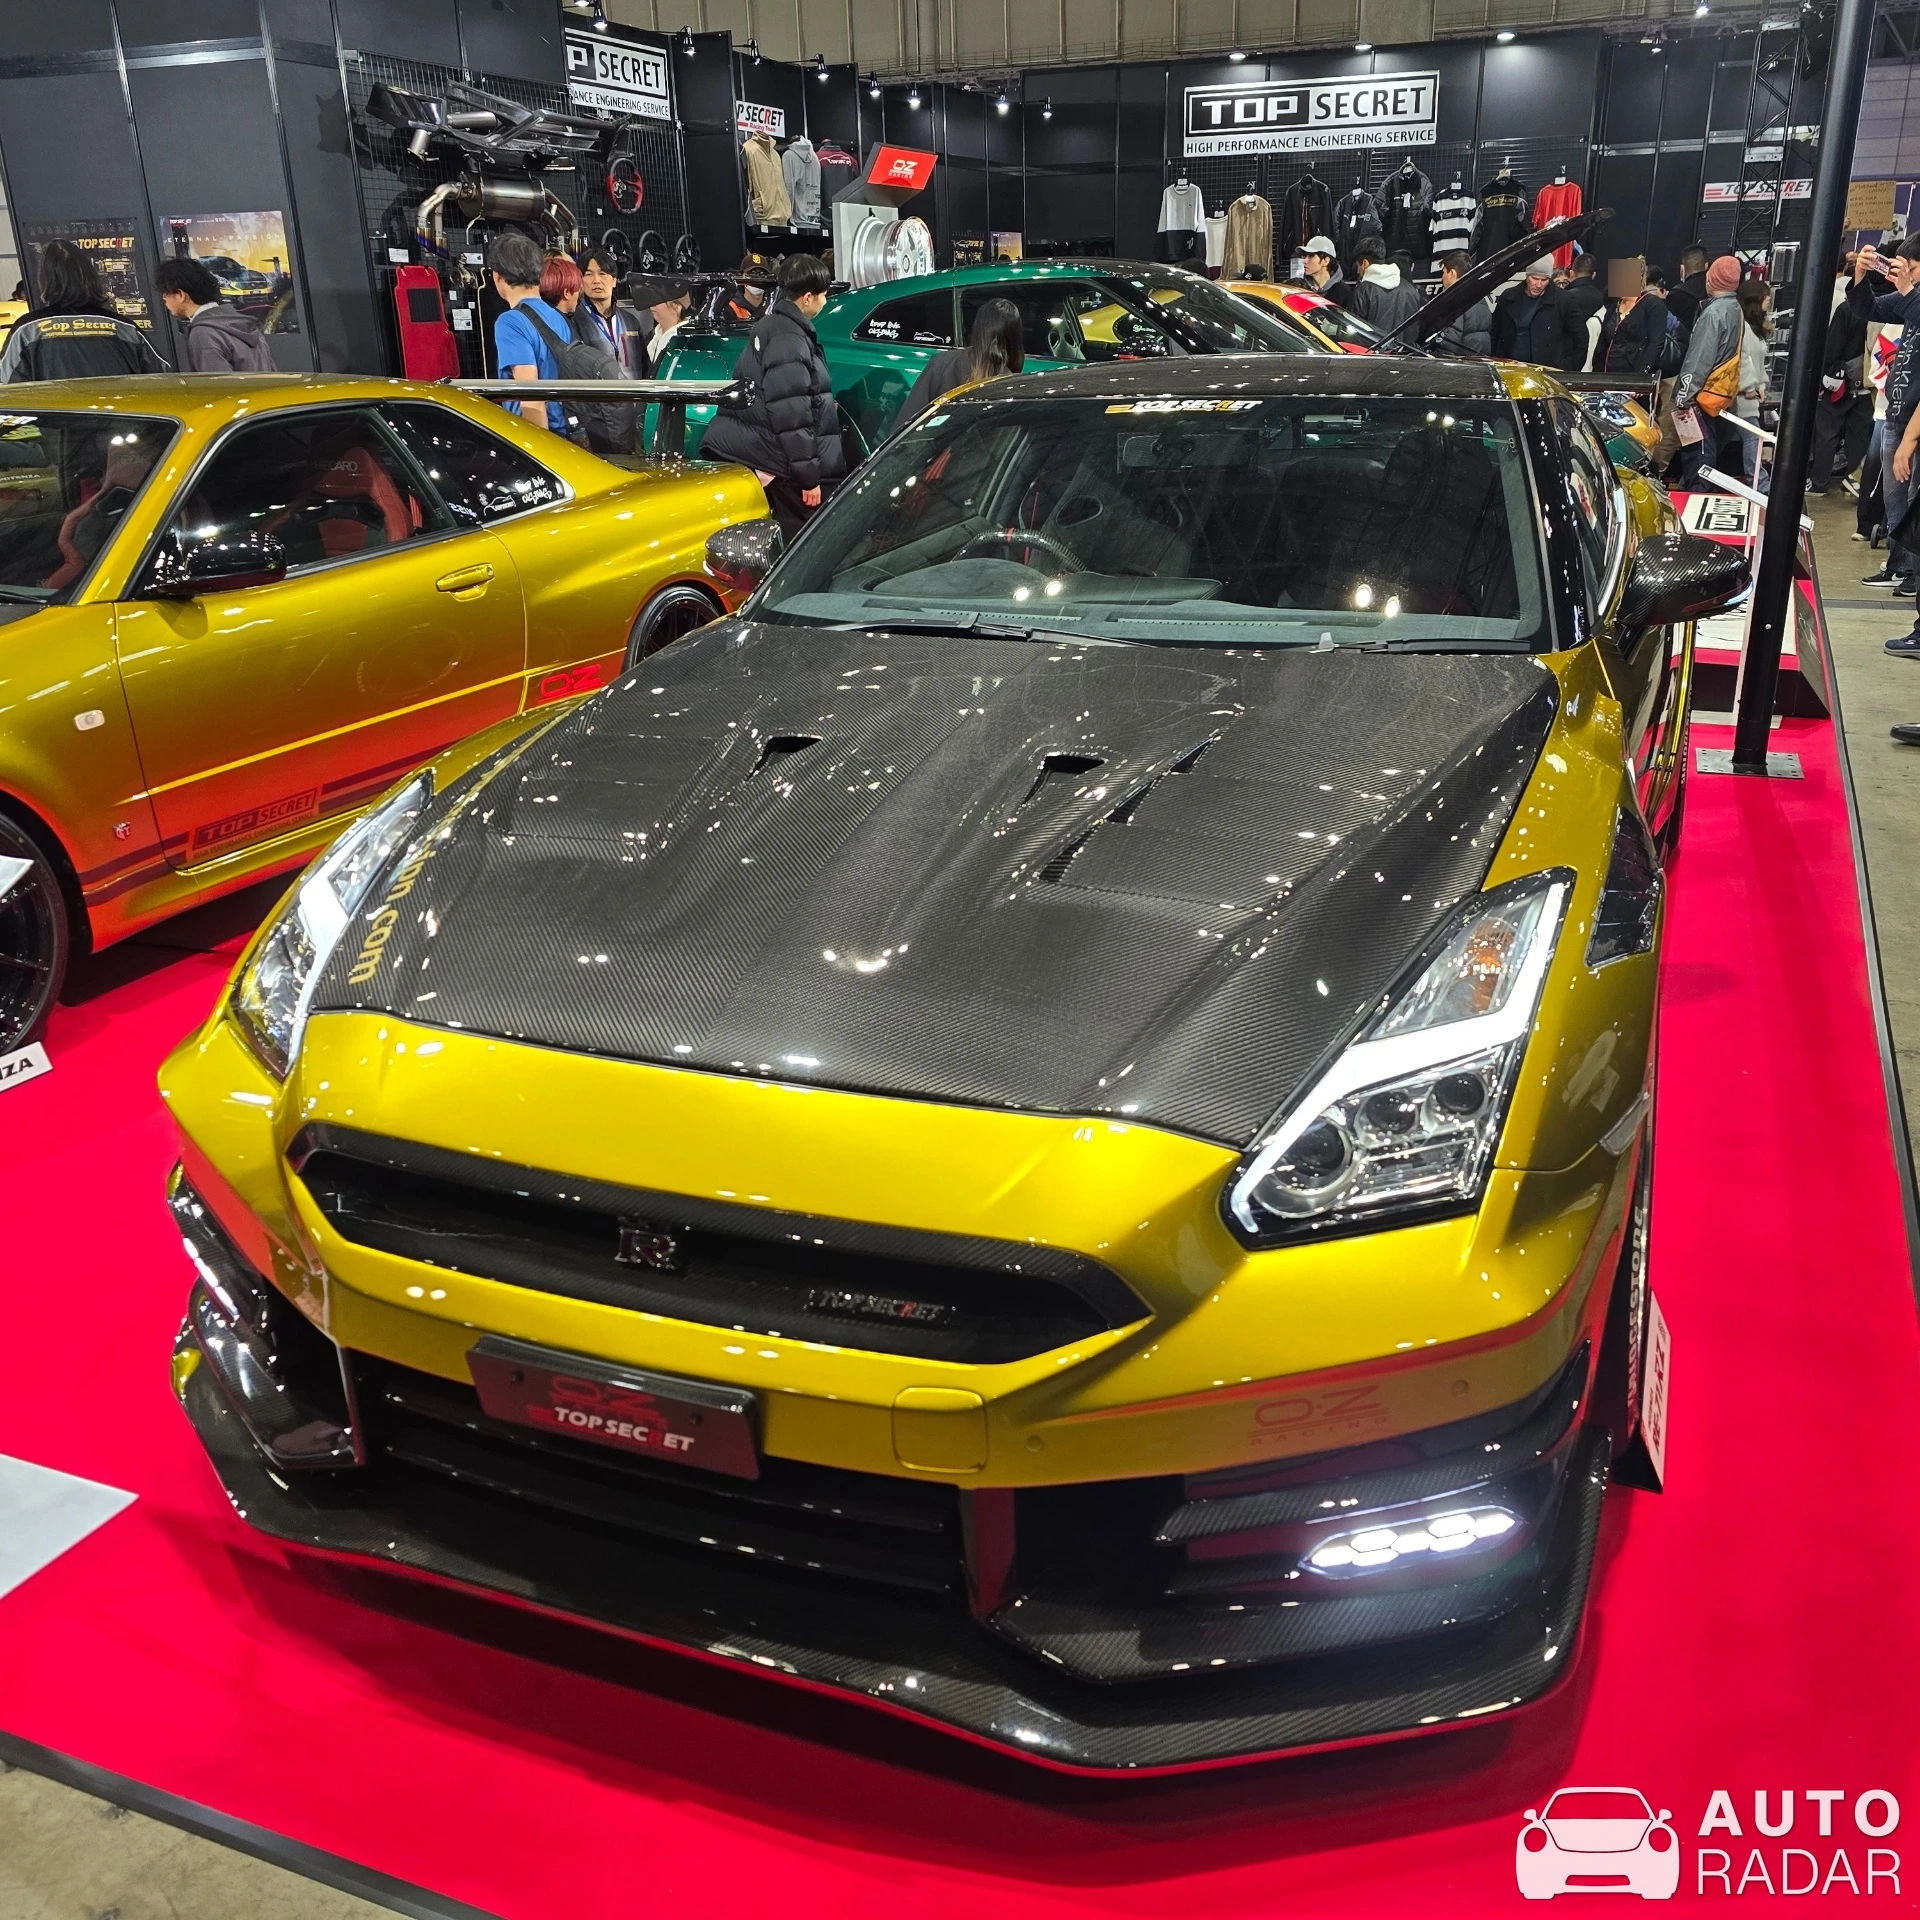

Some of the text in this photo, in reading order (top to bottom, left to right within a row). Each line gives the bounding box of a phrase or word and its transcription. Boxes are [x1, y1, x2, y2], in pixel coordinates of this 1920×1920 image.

[566, 44, 661, 88] P SECRET
[596, 93, 642, 112] ENGINEERING
[643, 102, 669, 117] SERVICE
[745, 105, 783, 127] SECRET
[1201, 86, 1427, 124] TOP SECRET
[1186, 129, 1434, 154] HIGH PERFORMANCE ENGINEERING SERVICE
[893, 159, 918, 172] OZ
[78, 236, 134, 250] TOP SECRET
[167, 235, 217, 243] ETERNAL
[38, 318, 117, 331] Top Secret
[1891, 370, 1912, 417] Klein
[1709, 513, 1738, 530] TOP
[540, 663, 602, 698] OZ
[200, 794, 313, 840] TOP SECRET
[1254, 1384, 1382, 1427] OZ
[554, 1406, 603, 1430] TOP
[1250, 1417, 1388, 1446] RACING
